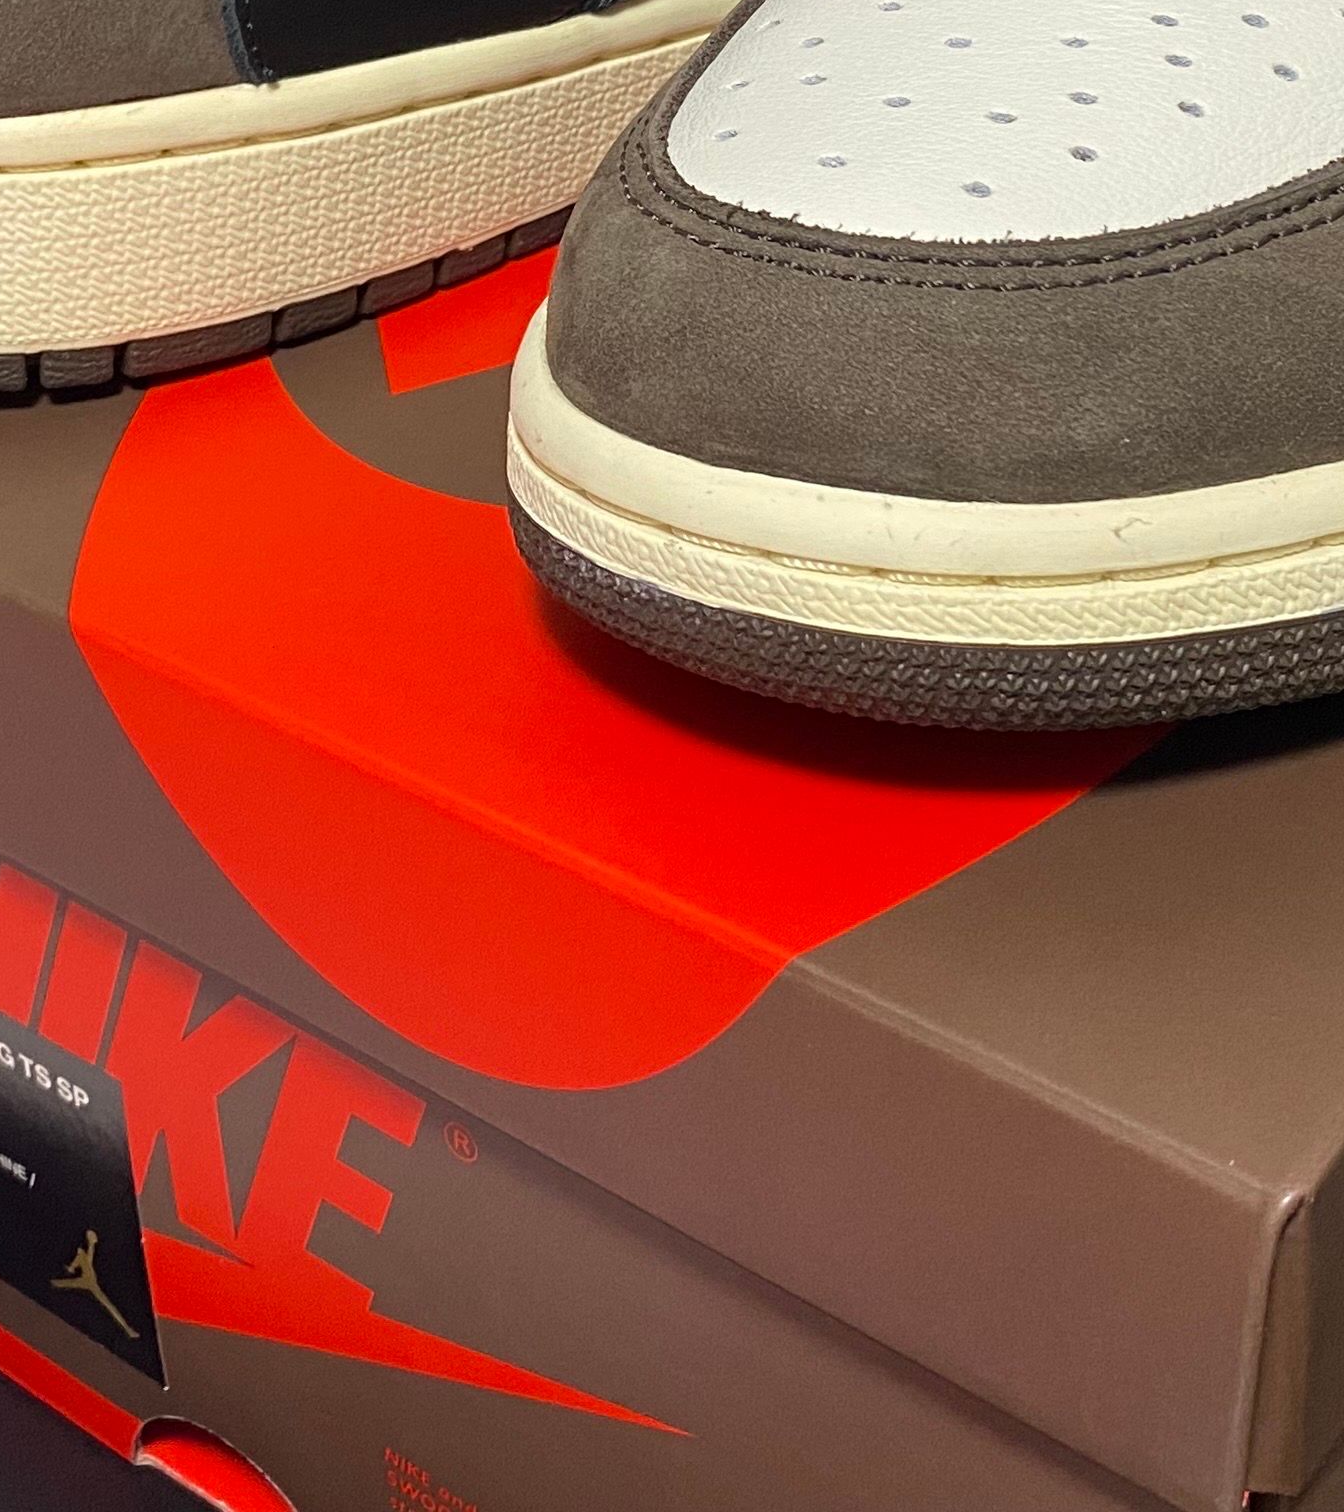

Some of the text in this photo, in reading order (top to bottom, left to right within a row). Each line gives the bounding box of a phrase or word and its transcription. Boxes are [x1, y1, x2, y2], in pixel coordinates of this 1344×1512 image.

[16, 1050, 52, 1092] TS
[56, 1073, 90, 1109] SP
[384, 1447, 431, 1487] NIKE
